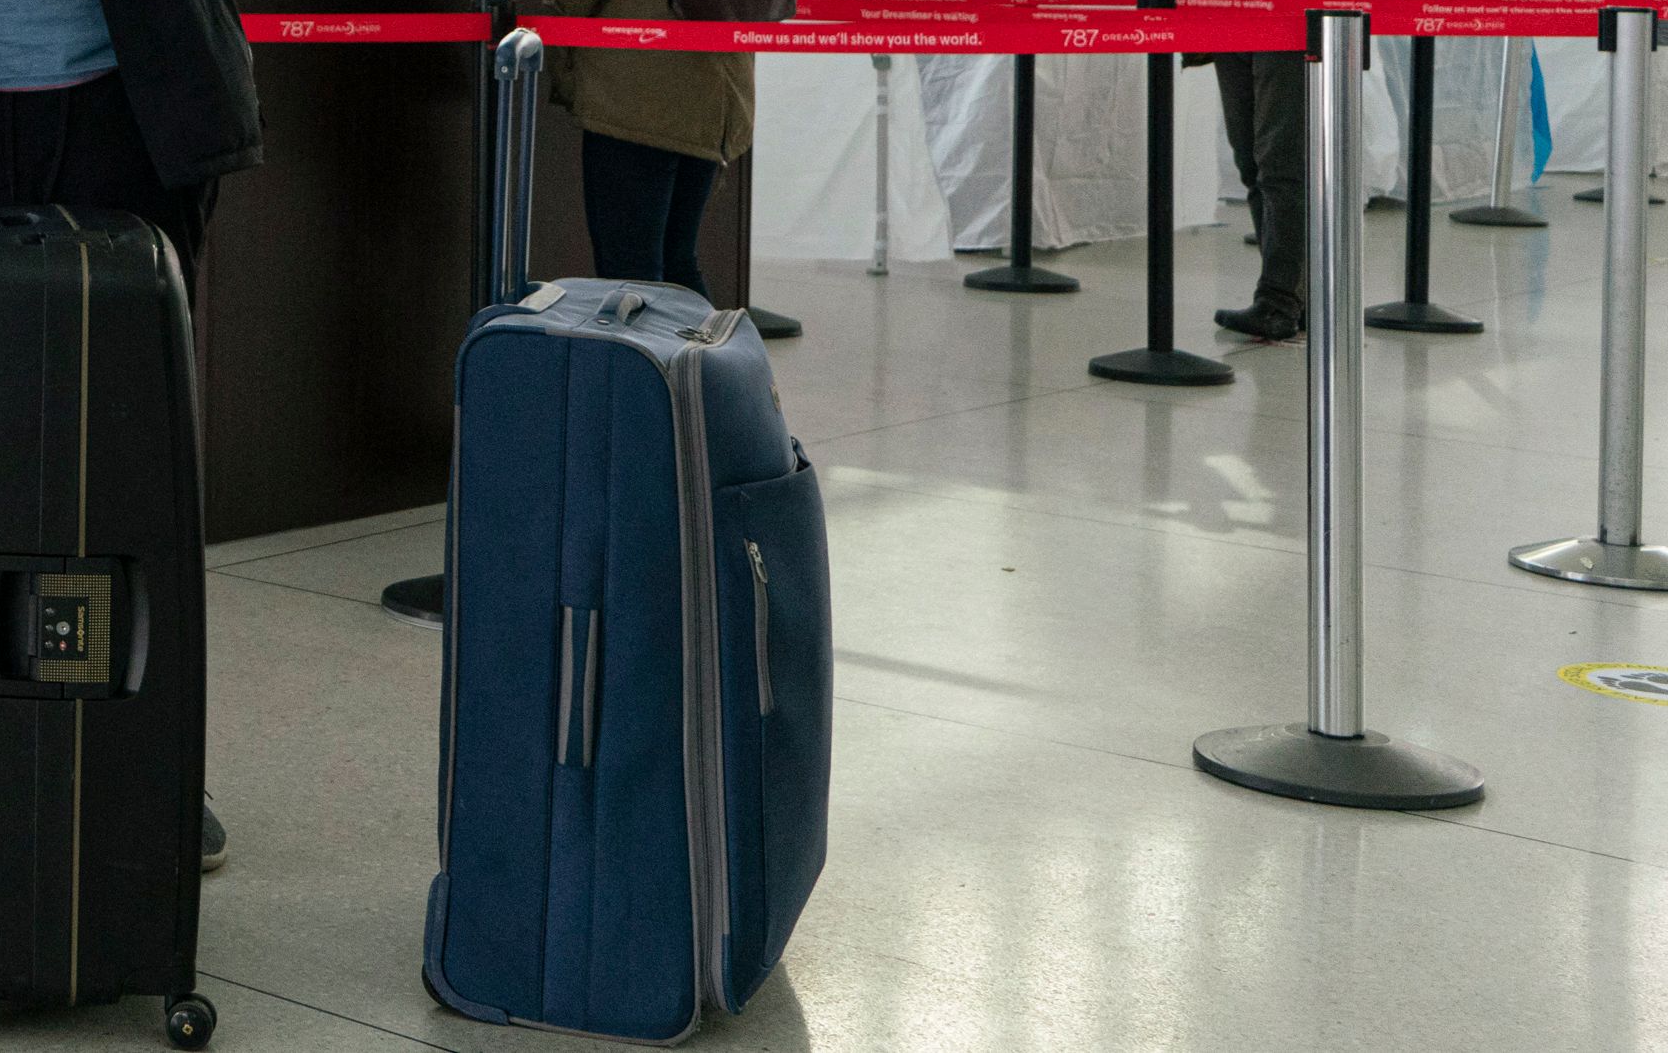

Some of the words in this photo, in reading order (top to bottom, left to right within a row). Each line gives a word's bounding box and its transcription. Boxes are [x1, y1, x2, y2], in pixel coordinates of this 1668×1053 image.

[280, 21, 314, 37] 787
[1413, 17, 1445, 32] 787
[734, 30, 773, 45] Follow
[776, 34, 790, 45] us
[792, 31, 816, 45] and
[850, 32, 884, 46] show
[886, 34, 911, 48] you
[914, 32, 937, 46] the
[939, 32, 983, 46] world.
[1060, 29, 1099, 47] 787
